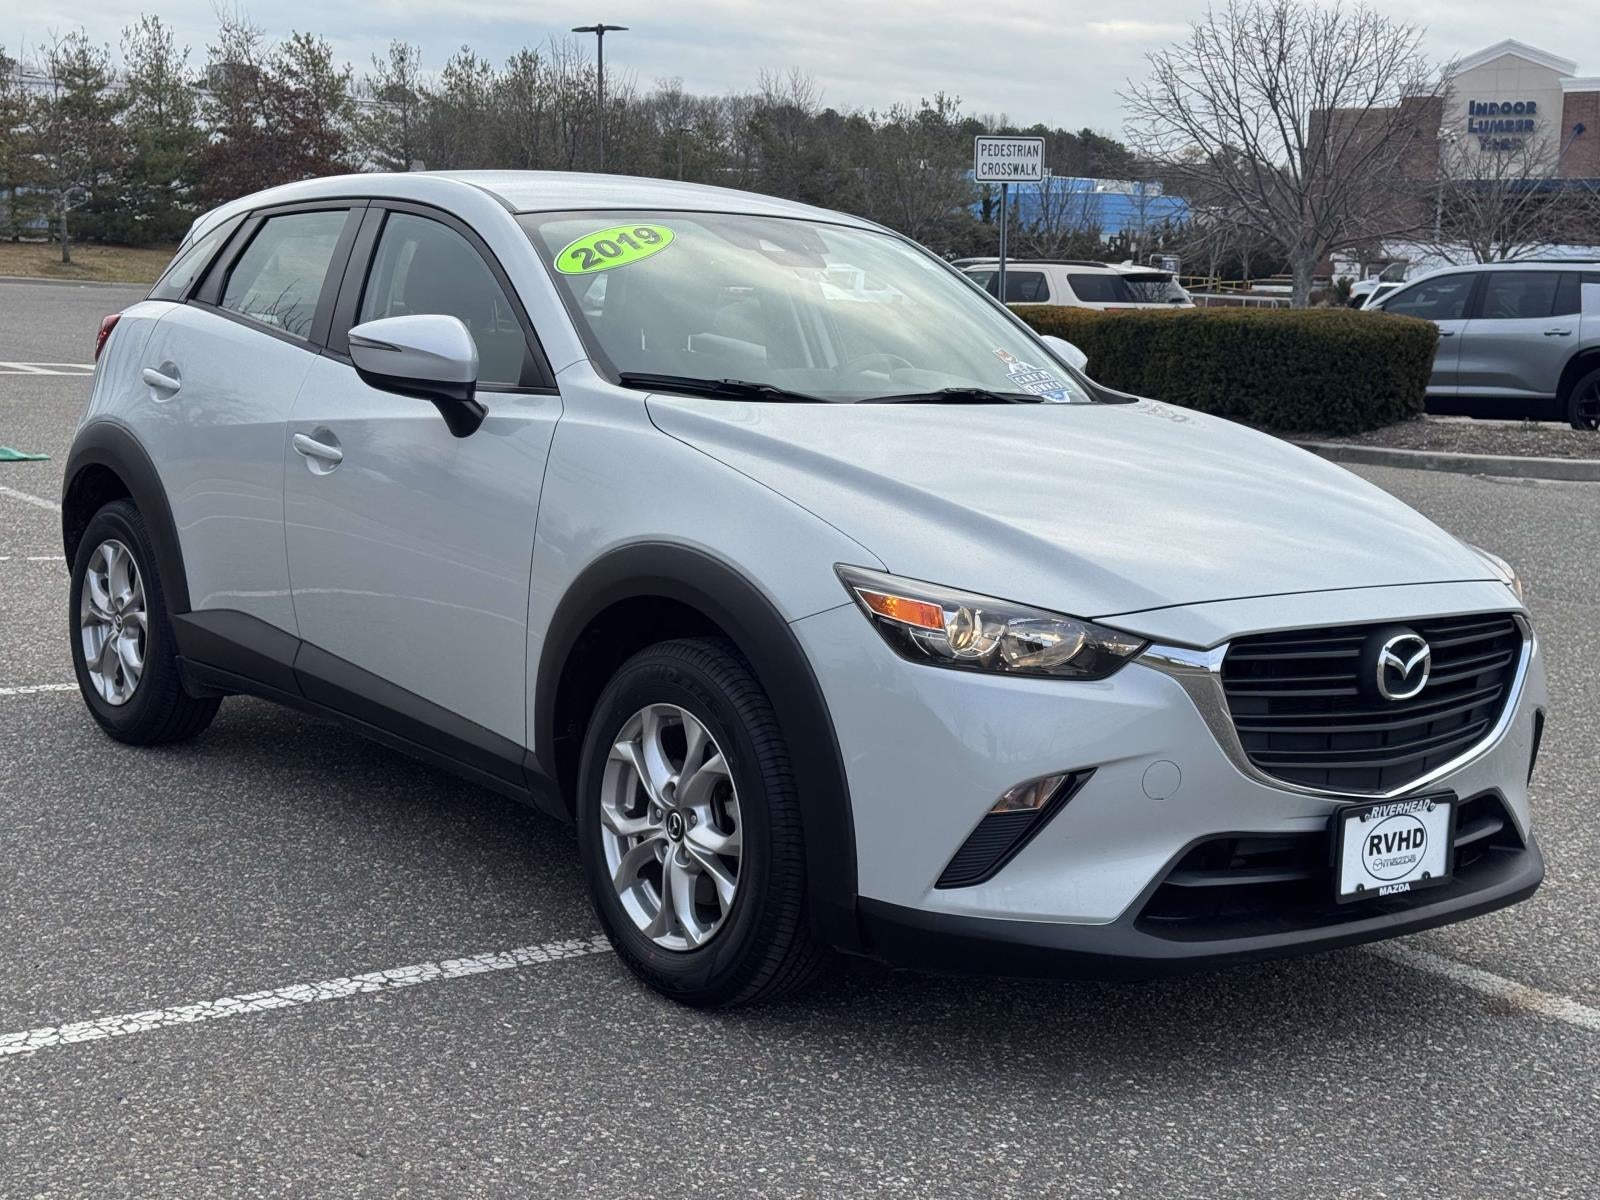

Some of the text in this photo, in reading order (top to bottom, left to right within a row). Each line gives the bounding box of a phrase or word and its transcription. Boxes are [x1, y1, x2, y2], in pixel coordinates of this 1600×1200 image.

[1468, 100, 1537, 116] INDOOR
[980, 144, 1040, 157] PEDESTRIAN
[981, 162, 1038, 176] CROSSWALK
[570, 227, 664, 270] 2019
[1370, 799, 1431, 818] RIVERHEAD
[1368, 827, 1425, 857] RVHD
[1379, 882, 1411, 896] MAZDA
